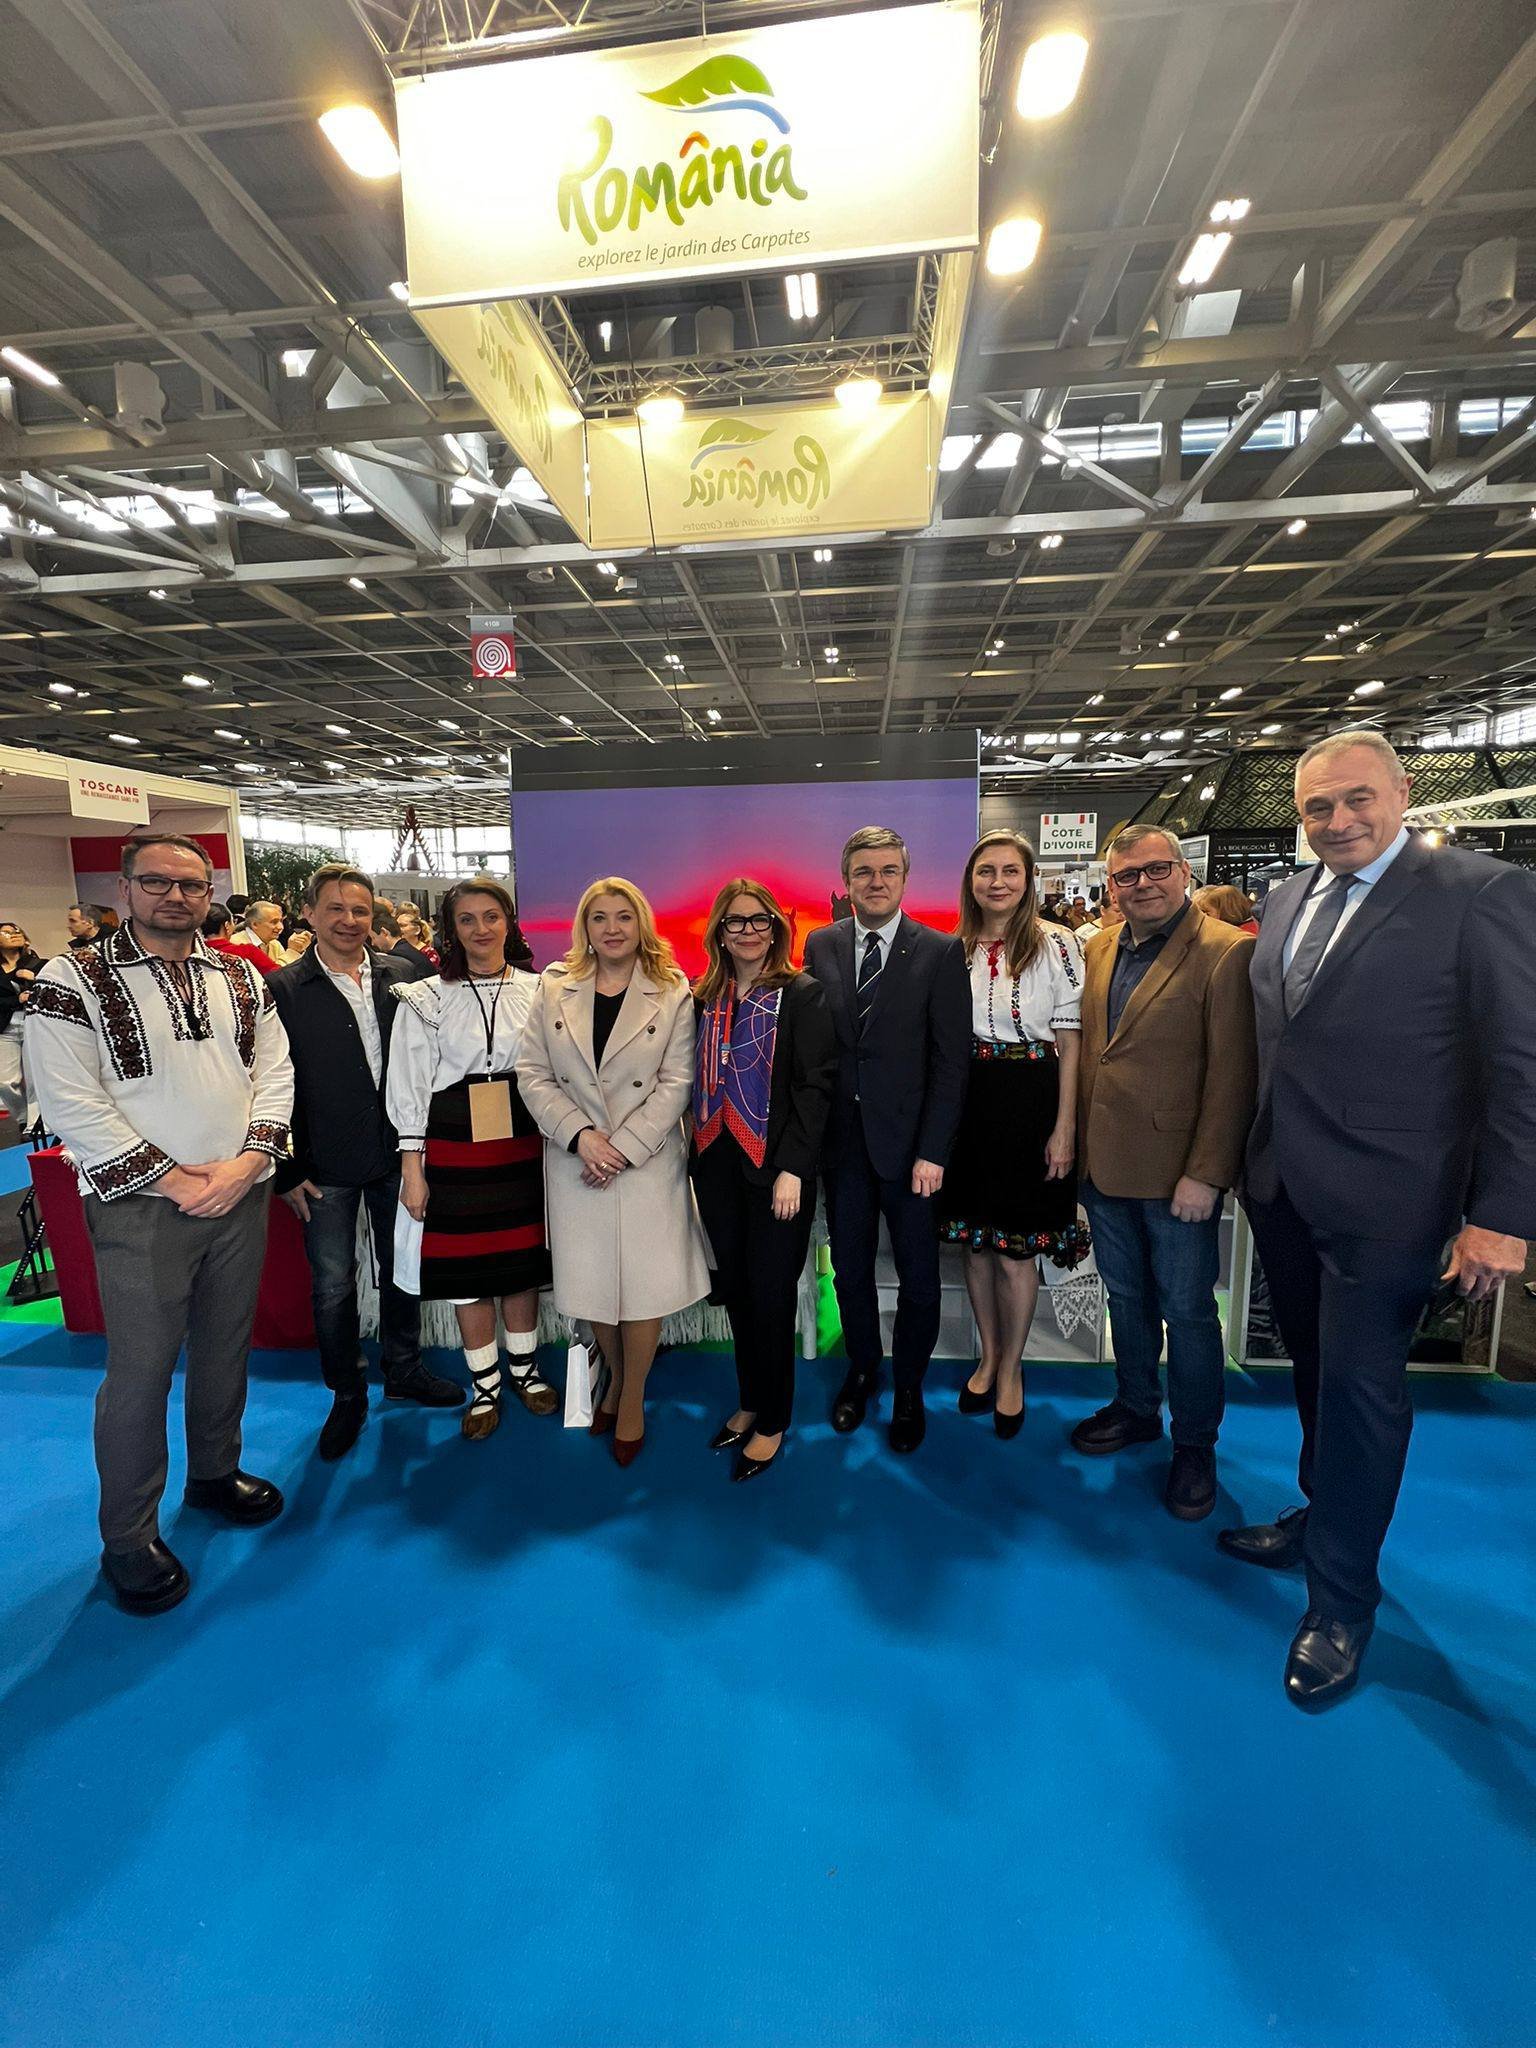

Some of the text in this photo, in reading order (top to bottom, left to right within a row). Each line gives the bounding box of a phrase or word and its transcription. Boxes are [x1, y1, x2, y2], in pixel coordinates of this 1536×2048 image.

[557, 114, 808, 246] România
[577, 229, 811, 271] explorez le jardin des Carpates
[79, 778, 139, 797] TOSCANE
[1043, 840, 1094, 850] D'IVOIRE
